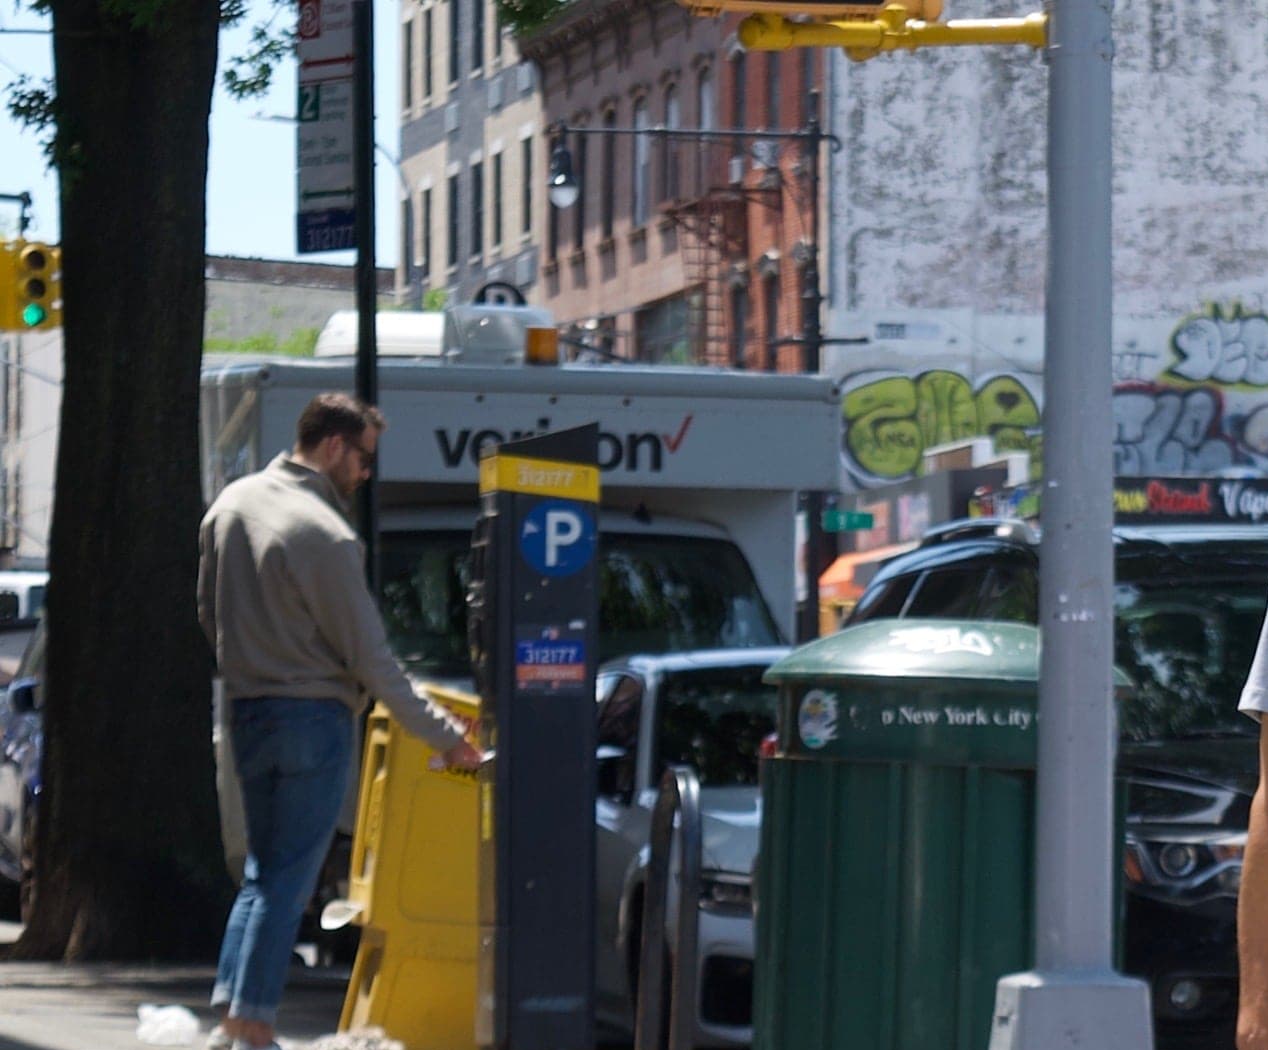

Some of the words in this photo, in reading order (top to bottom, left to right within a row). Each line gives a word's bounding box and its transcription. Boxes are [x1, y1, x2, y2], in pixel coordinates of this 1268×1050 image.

[302, 86, 317, 119] 2
[545, 511, 583, 568] P
[524, 646, 578, 664] 312177
[899, 706, 938, 725] New
[946, 706, 988, 725] York
